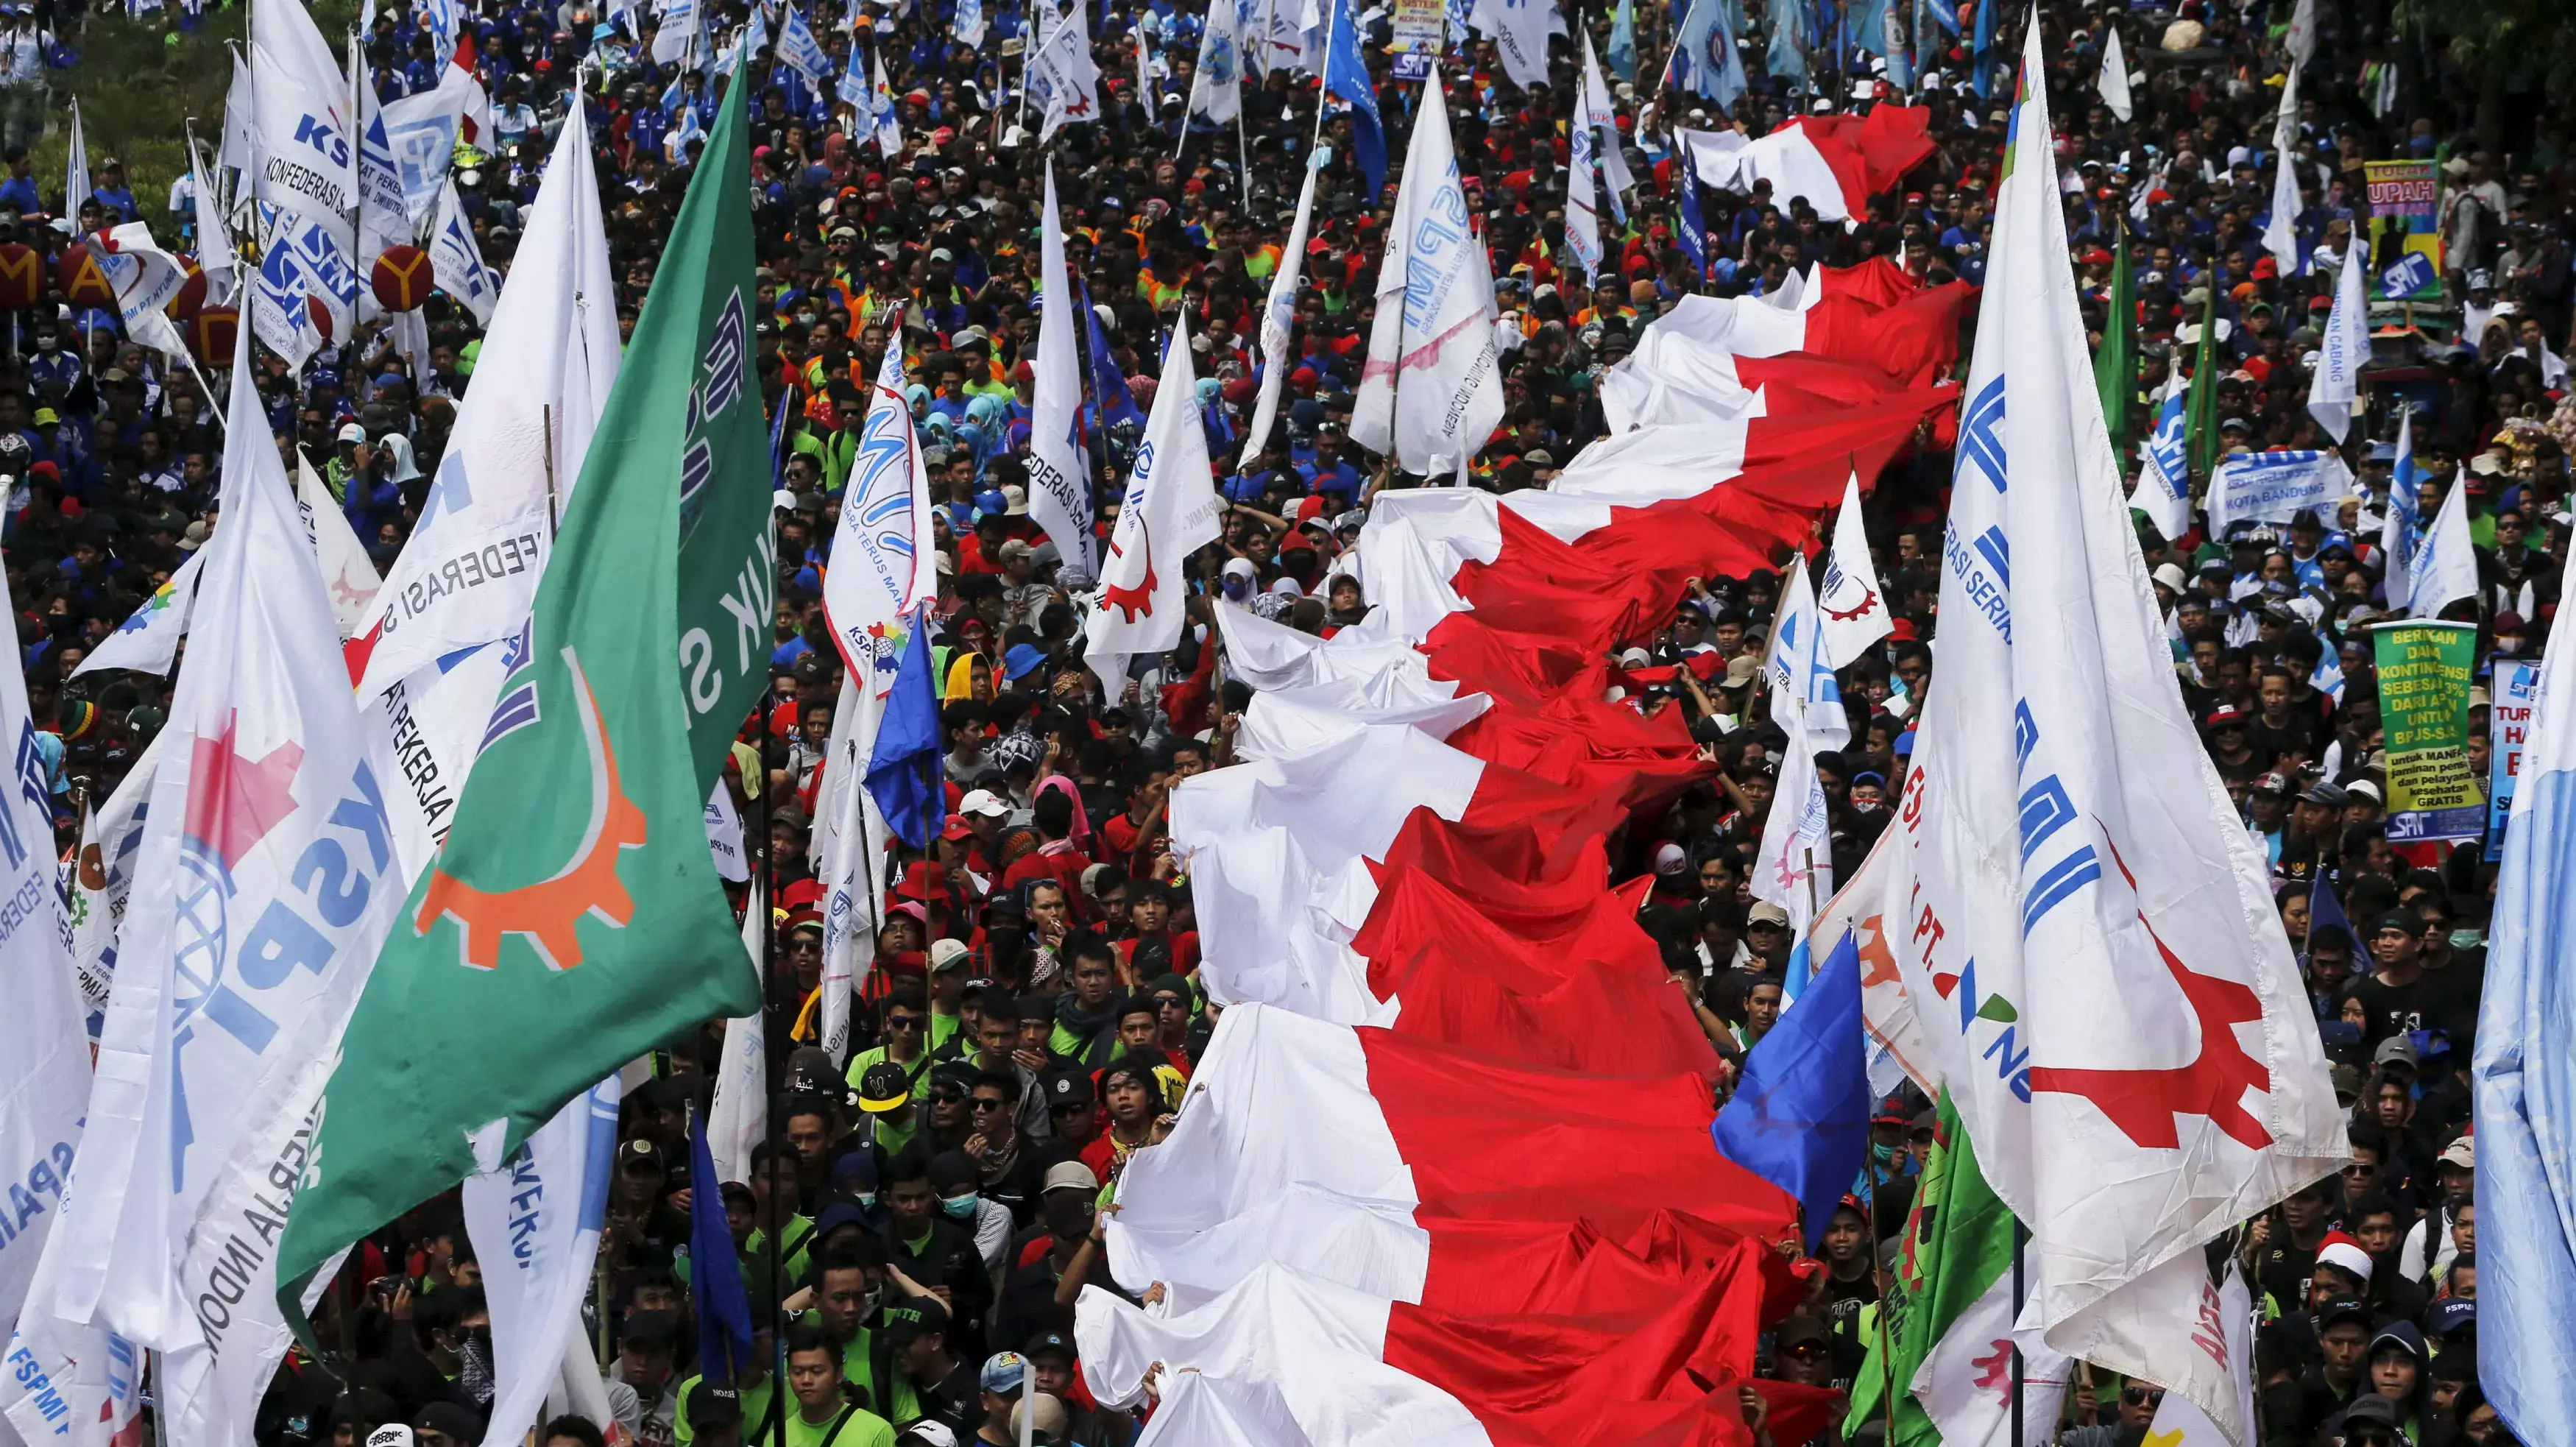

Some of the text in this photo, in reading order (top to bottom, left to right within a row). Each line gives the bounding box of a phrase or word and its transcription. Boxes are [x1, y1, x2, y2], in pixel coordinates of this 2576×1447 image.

[263, 156, 340, 209] KONFEDERASI
[2368, 181, 2436, 203] UPAH
[379, 250, 425, 311] Y
[139, 298, 152, 312] PT
[2329, 335, 2343, 383] CABANG
[2226, 482, 2326, 511] KOTA BANDUNG
[857, 529, 888, 579] TERUS
[2393, 629, 2458, 645] BERIKAN
[2445, 682, 2466, 698] 3%
[2392, 693, 2458, 712] DARI APN
[390, 703, 454, 827] PEKERJA
[2391, 752, 2424, 766] untuk
[2391, 764, 2436, 779] jaminan
[2397, 777, 2418, 788] dan
[2409, 784, 2469, 796] kesehatan
[2417, 795, 2464, 807] GRATIS
[7, 1345, 69, 1426] FSPMI
